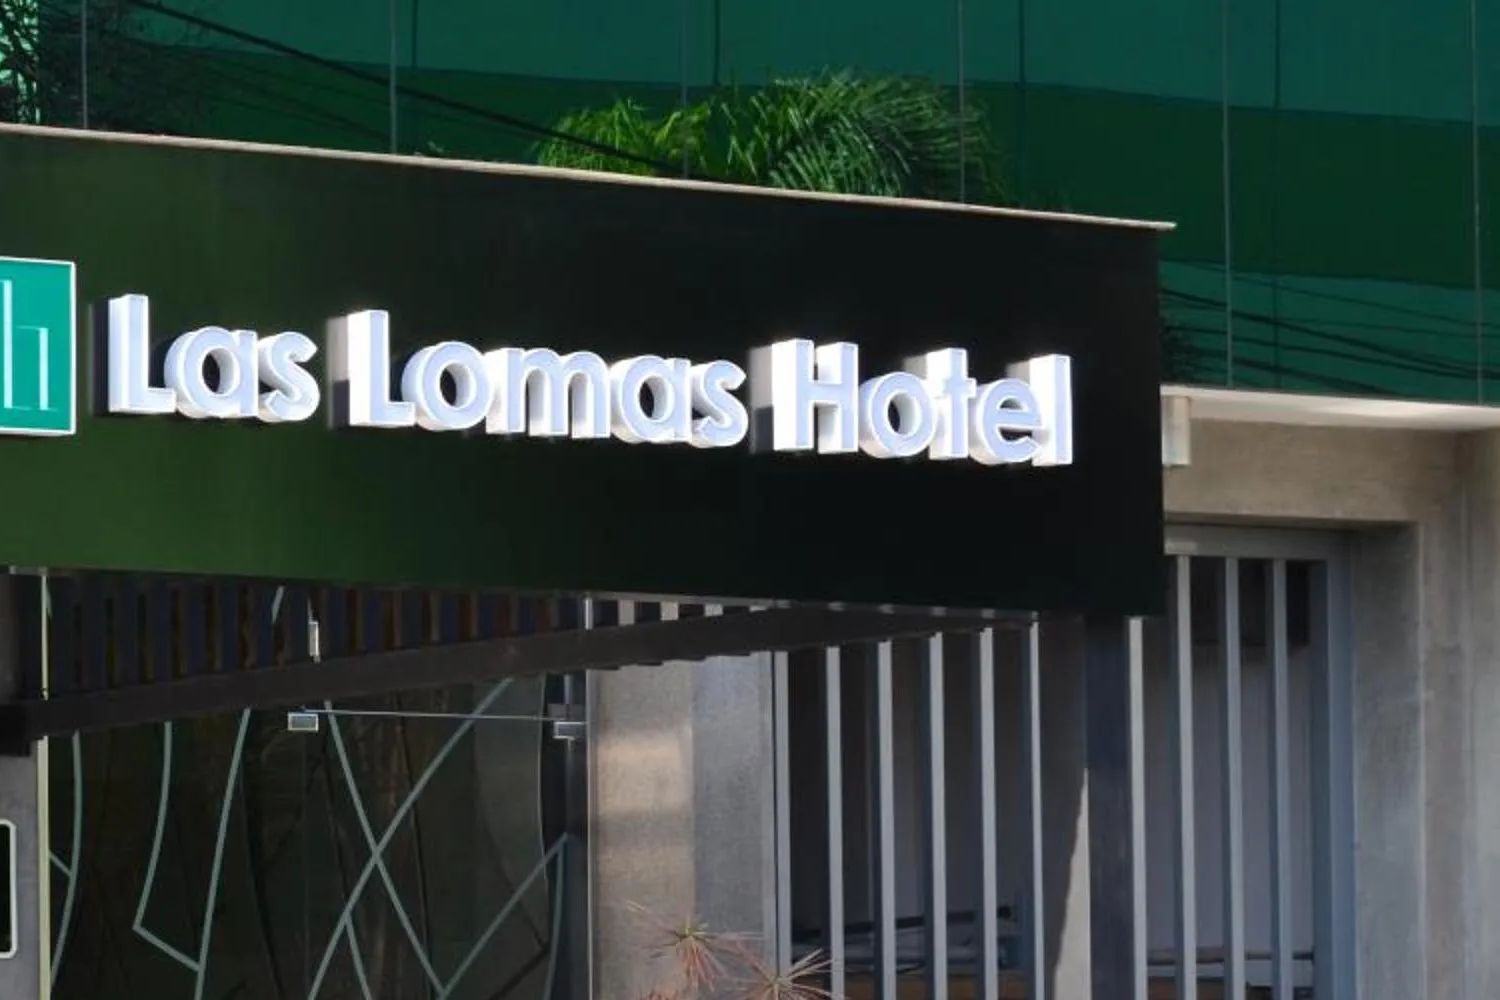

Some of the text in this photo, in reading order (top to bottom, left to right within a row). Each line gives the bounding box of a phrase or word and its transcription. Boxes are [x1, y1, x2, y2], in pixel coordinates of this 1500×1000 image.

[108, 293, 1074, 467] Las Lomas Hotel
